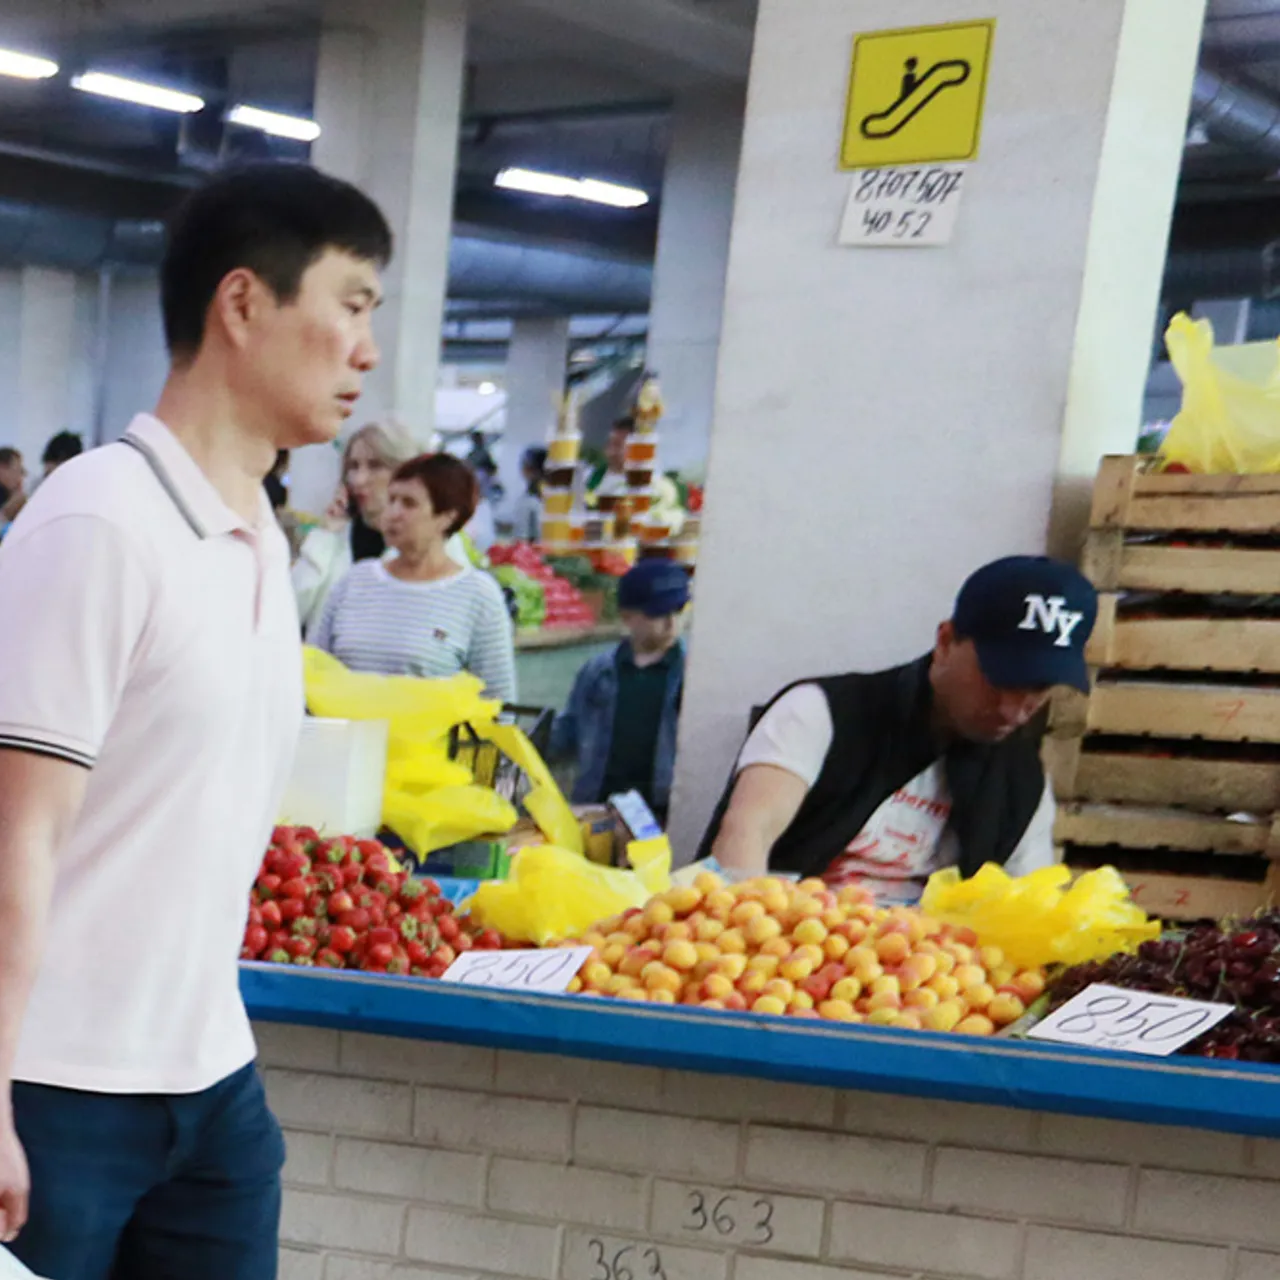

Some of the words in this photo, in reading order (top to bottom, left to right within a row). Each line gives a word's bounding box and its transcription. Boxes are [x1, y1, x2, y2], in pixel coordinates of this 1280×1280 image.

[1017, 593, 1084, 647] NY
[1056, 995, 1211, 1042] 850
[682, 1189, 775, 1246] 363
